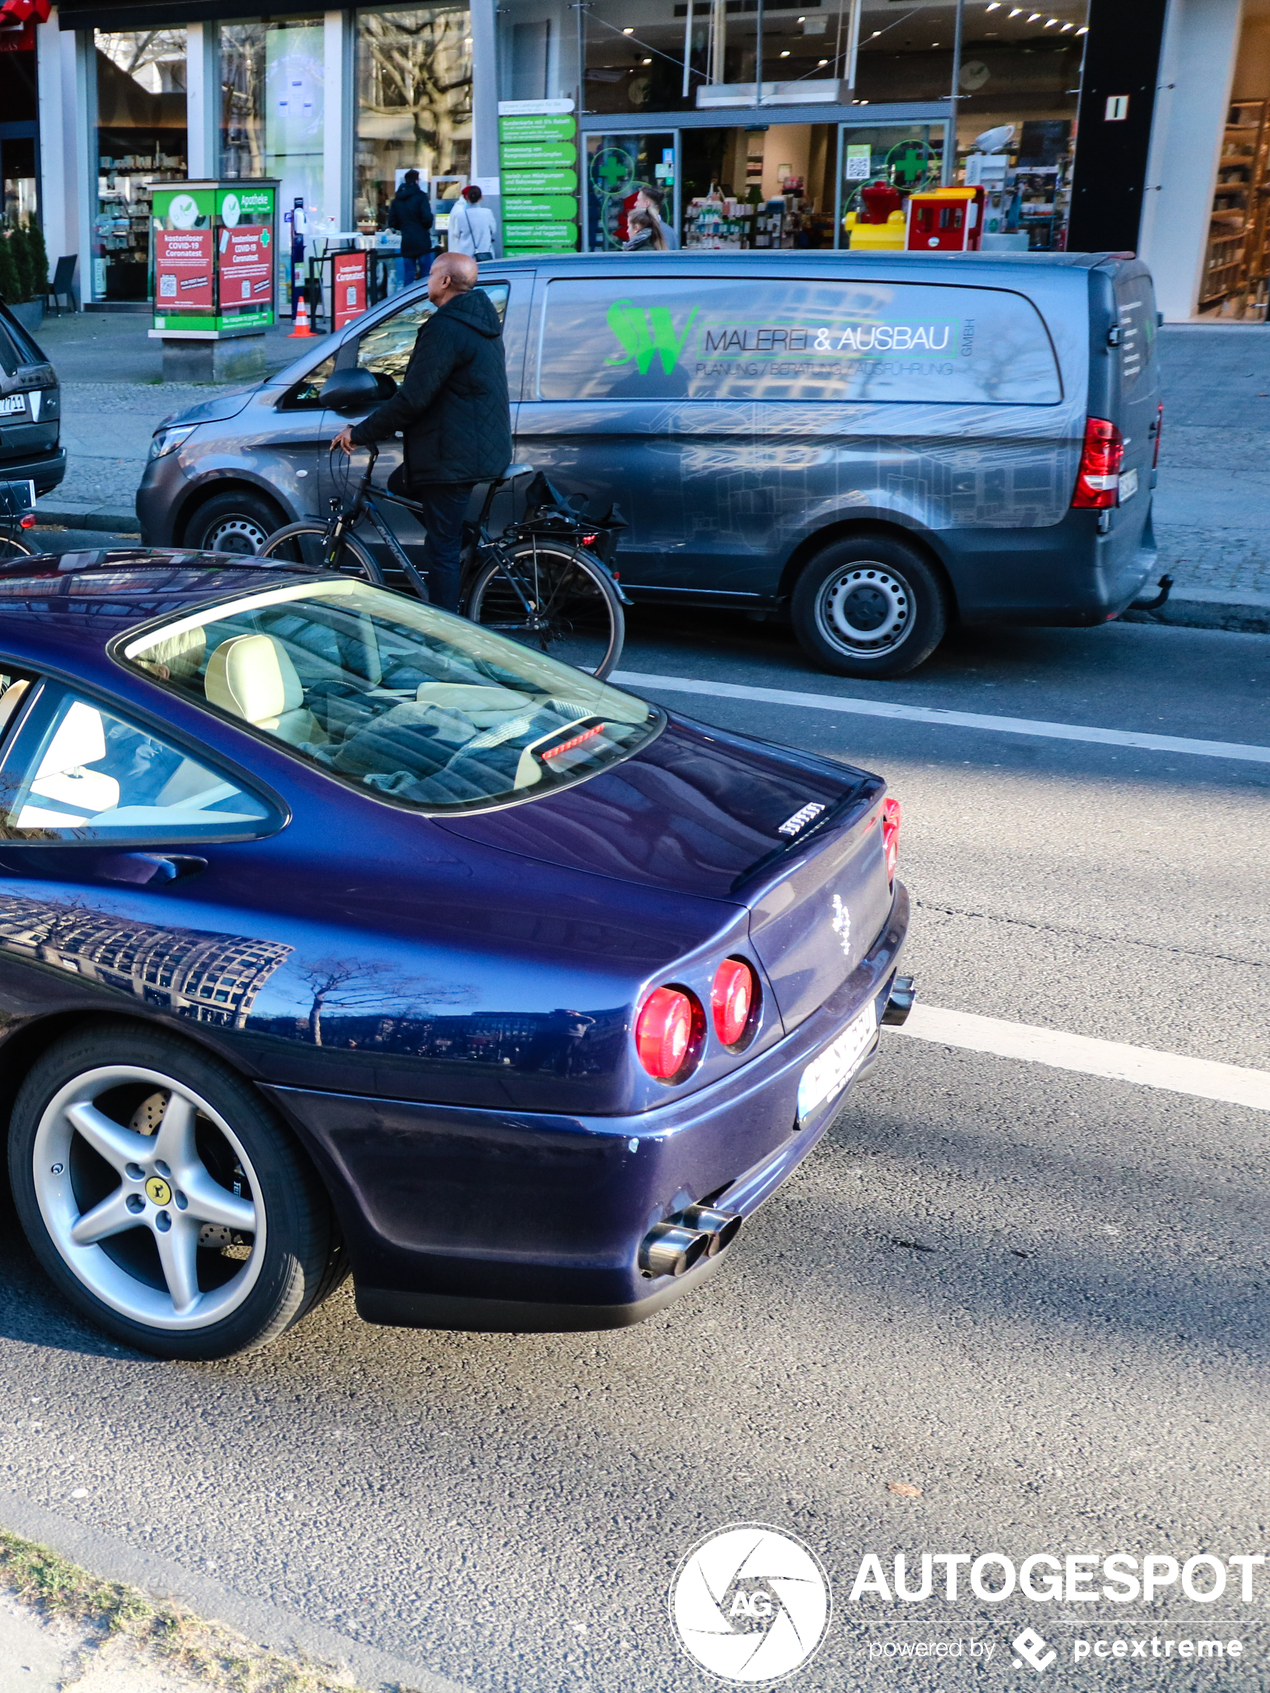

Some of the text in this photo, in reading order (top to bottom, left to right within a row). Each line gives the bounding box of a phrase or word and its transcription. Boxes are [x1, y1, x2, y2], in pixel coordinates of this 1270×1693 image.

[164, 234, 203, 242] kostenloser
[165, 249, 202, 257] Coronatest
[705, 326, 949, 352] MALEREI & AUSBAU
[961, 318, 975, 357] GMBH
[696, 362, 758, 376] PLANUNG
[770, 361, 842, 376] BERATUNG
[854, 358, 954, 376] AUSFÜHRUNG
